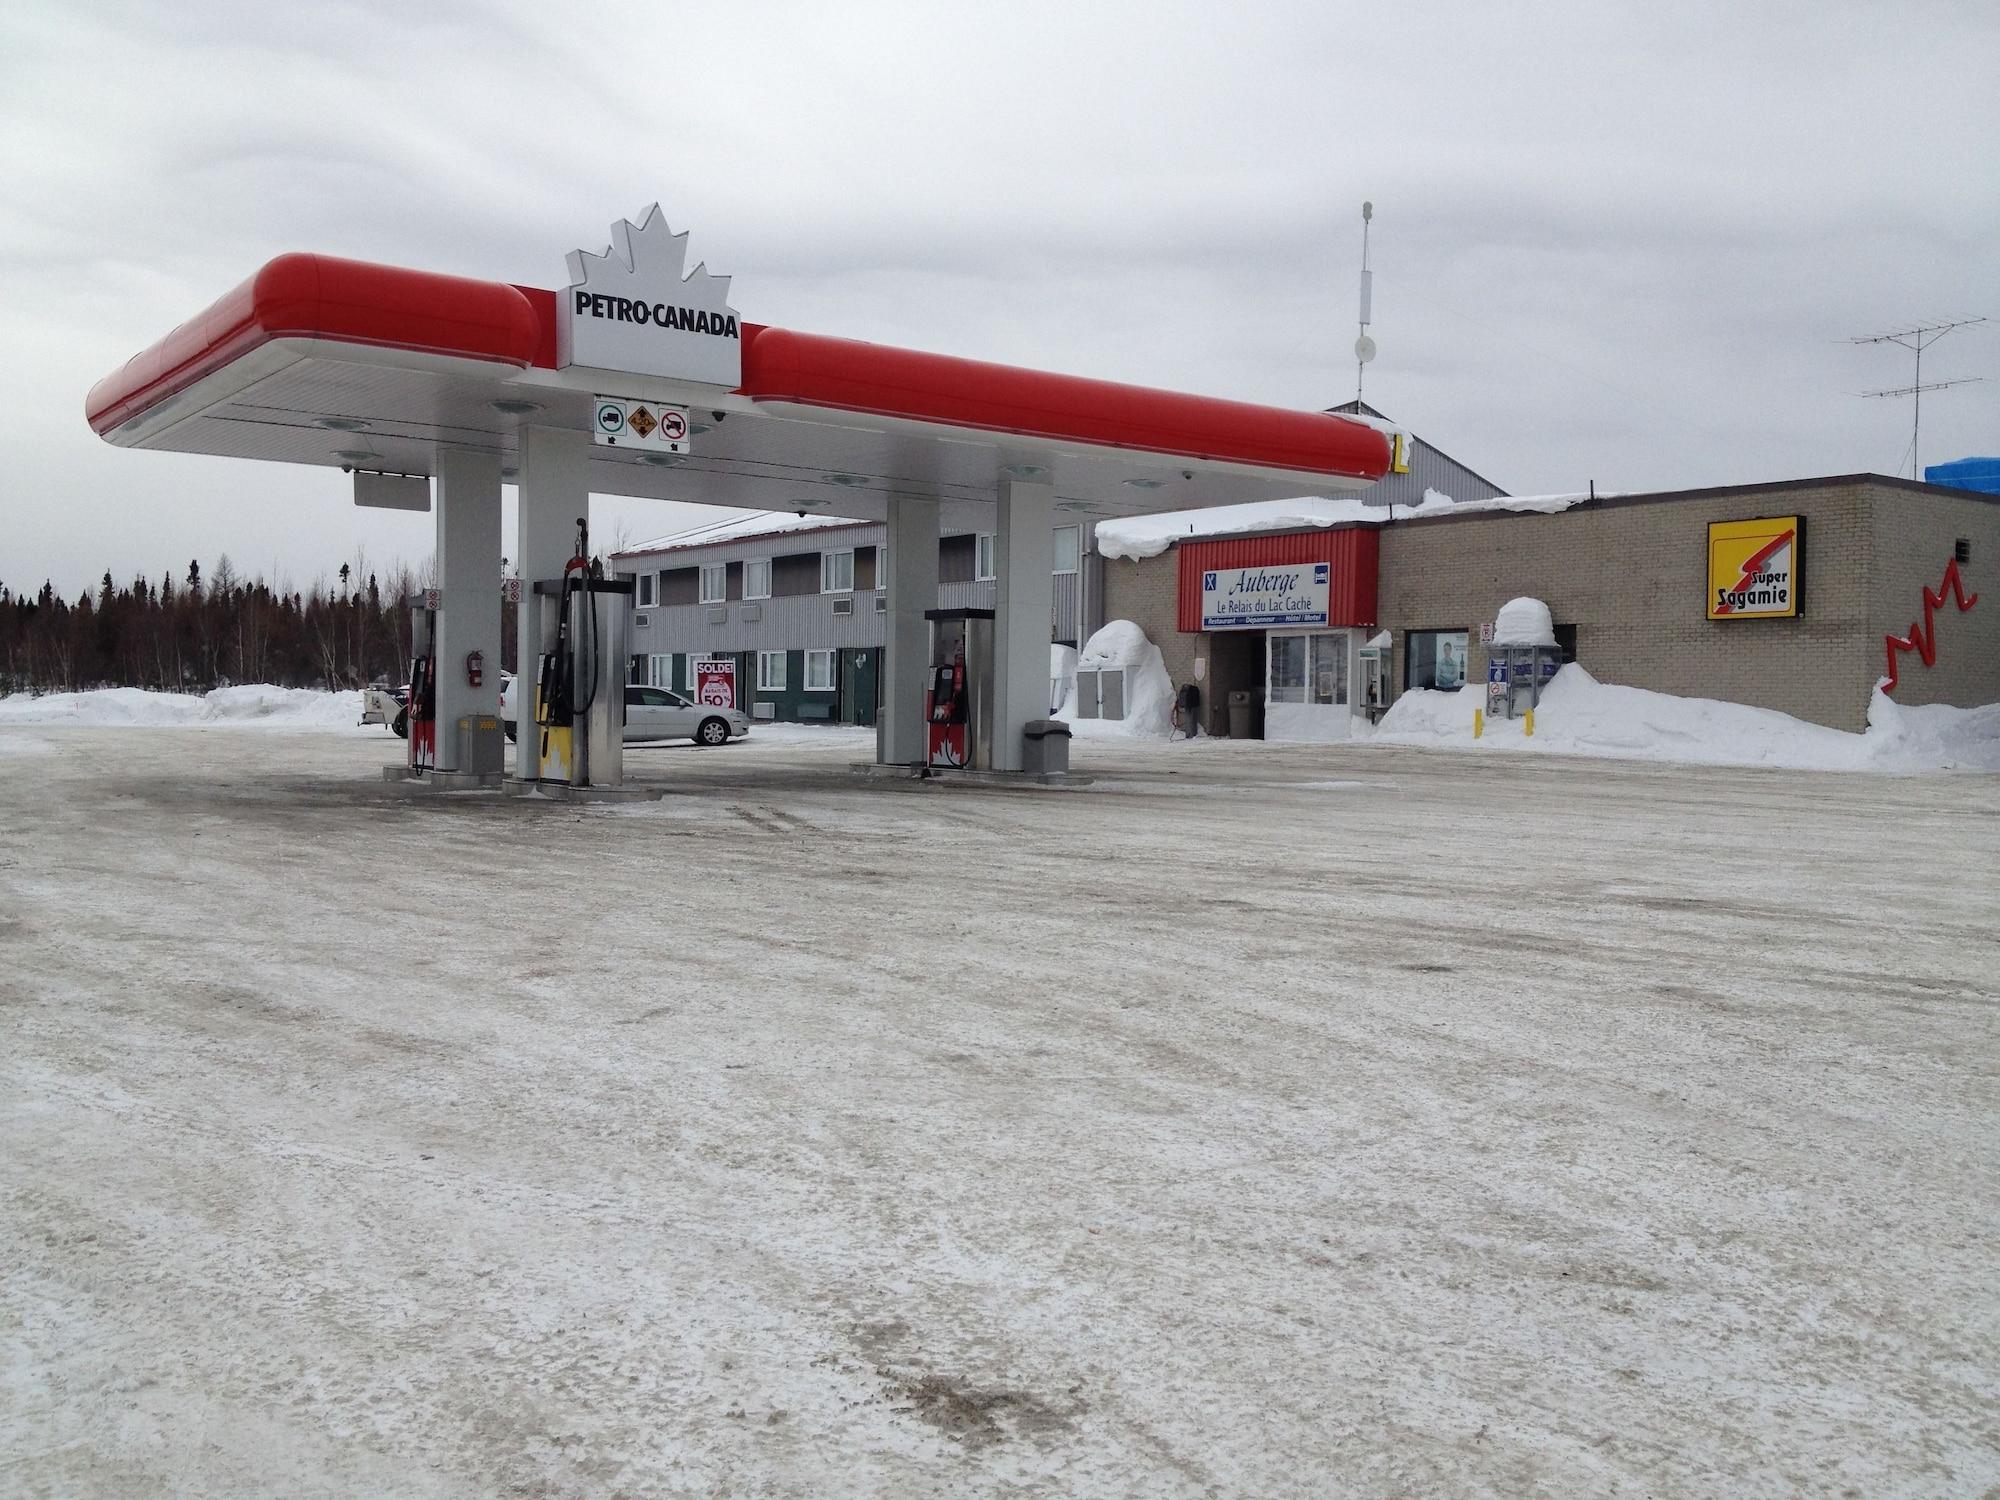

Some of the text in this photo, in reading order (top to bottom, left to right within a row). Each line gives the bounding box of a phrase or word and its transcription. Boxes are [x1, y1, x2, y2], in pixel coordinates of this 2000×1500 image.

[1229, 568, 1299, 597] Auberge
[1752, 572, 1787, 586] Super
[1217, 596, 1312, 614] Le Relais du Lac Caché
[1718, 586, 1787, 609] Sagamie
[698, 664, 732, 673] SOLDE!
